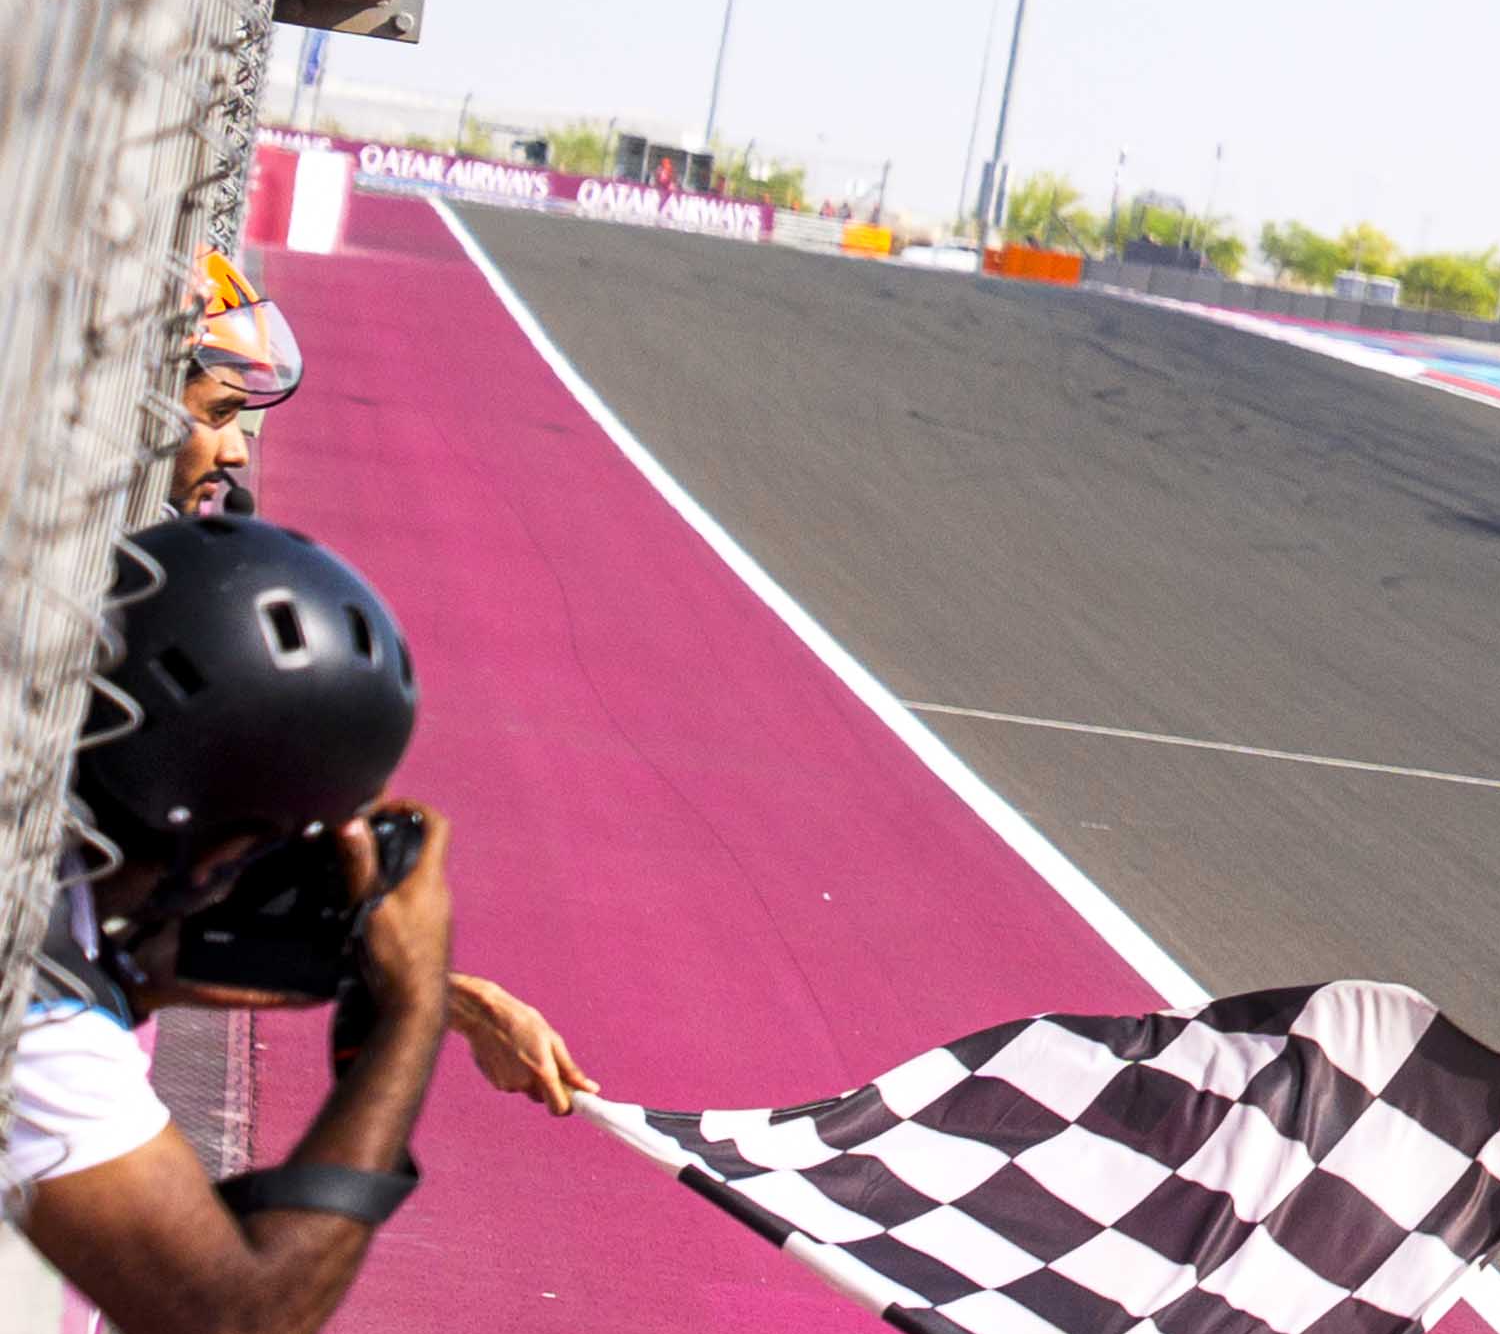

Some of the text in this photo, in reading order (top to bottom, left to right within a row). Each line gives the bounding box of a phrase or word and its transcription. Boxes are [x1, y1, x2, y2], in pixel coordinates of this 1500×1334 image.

[360, 146, 550, 200] QATAR AIRWAYS
[576, 177, 762, 232] QATAR AIRWAYS
